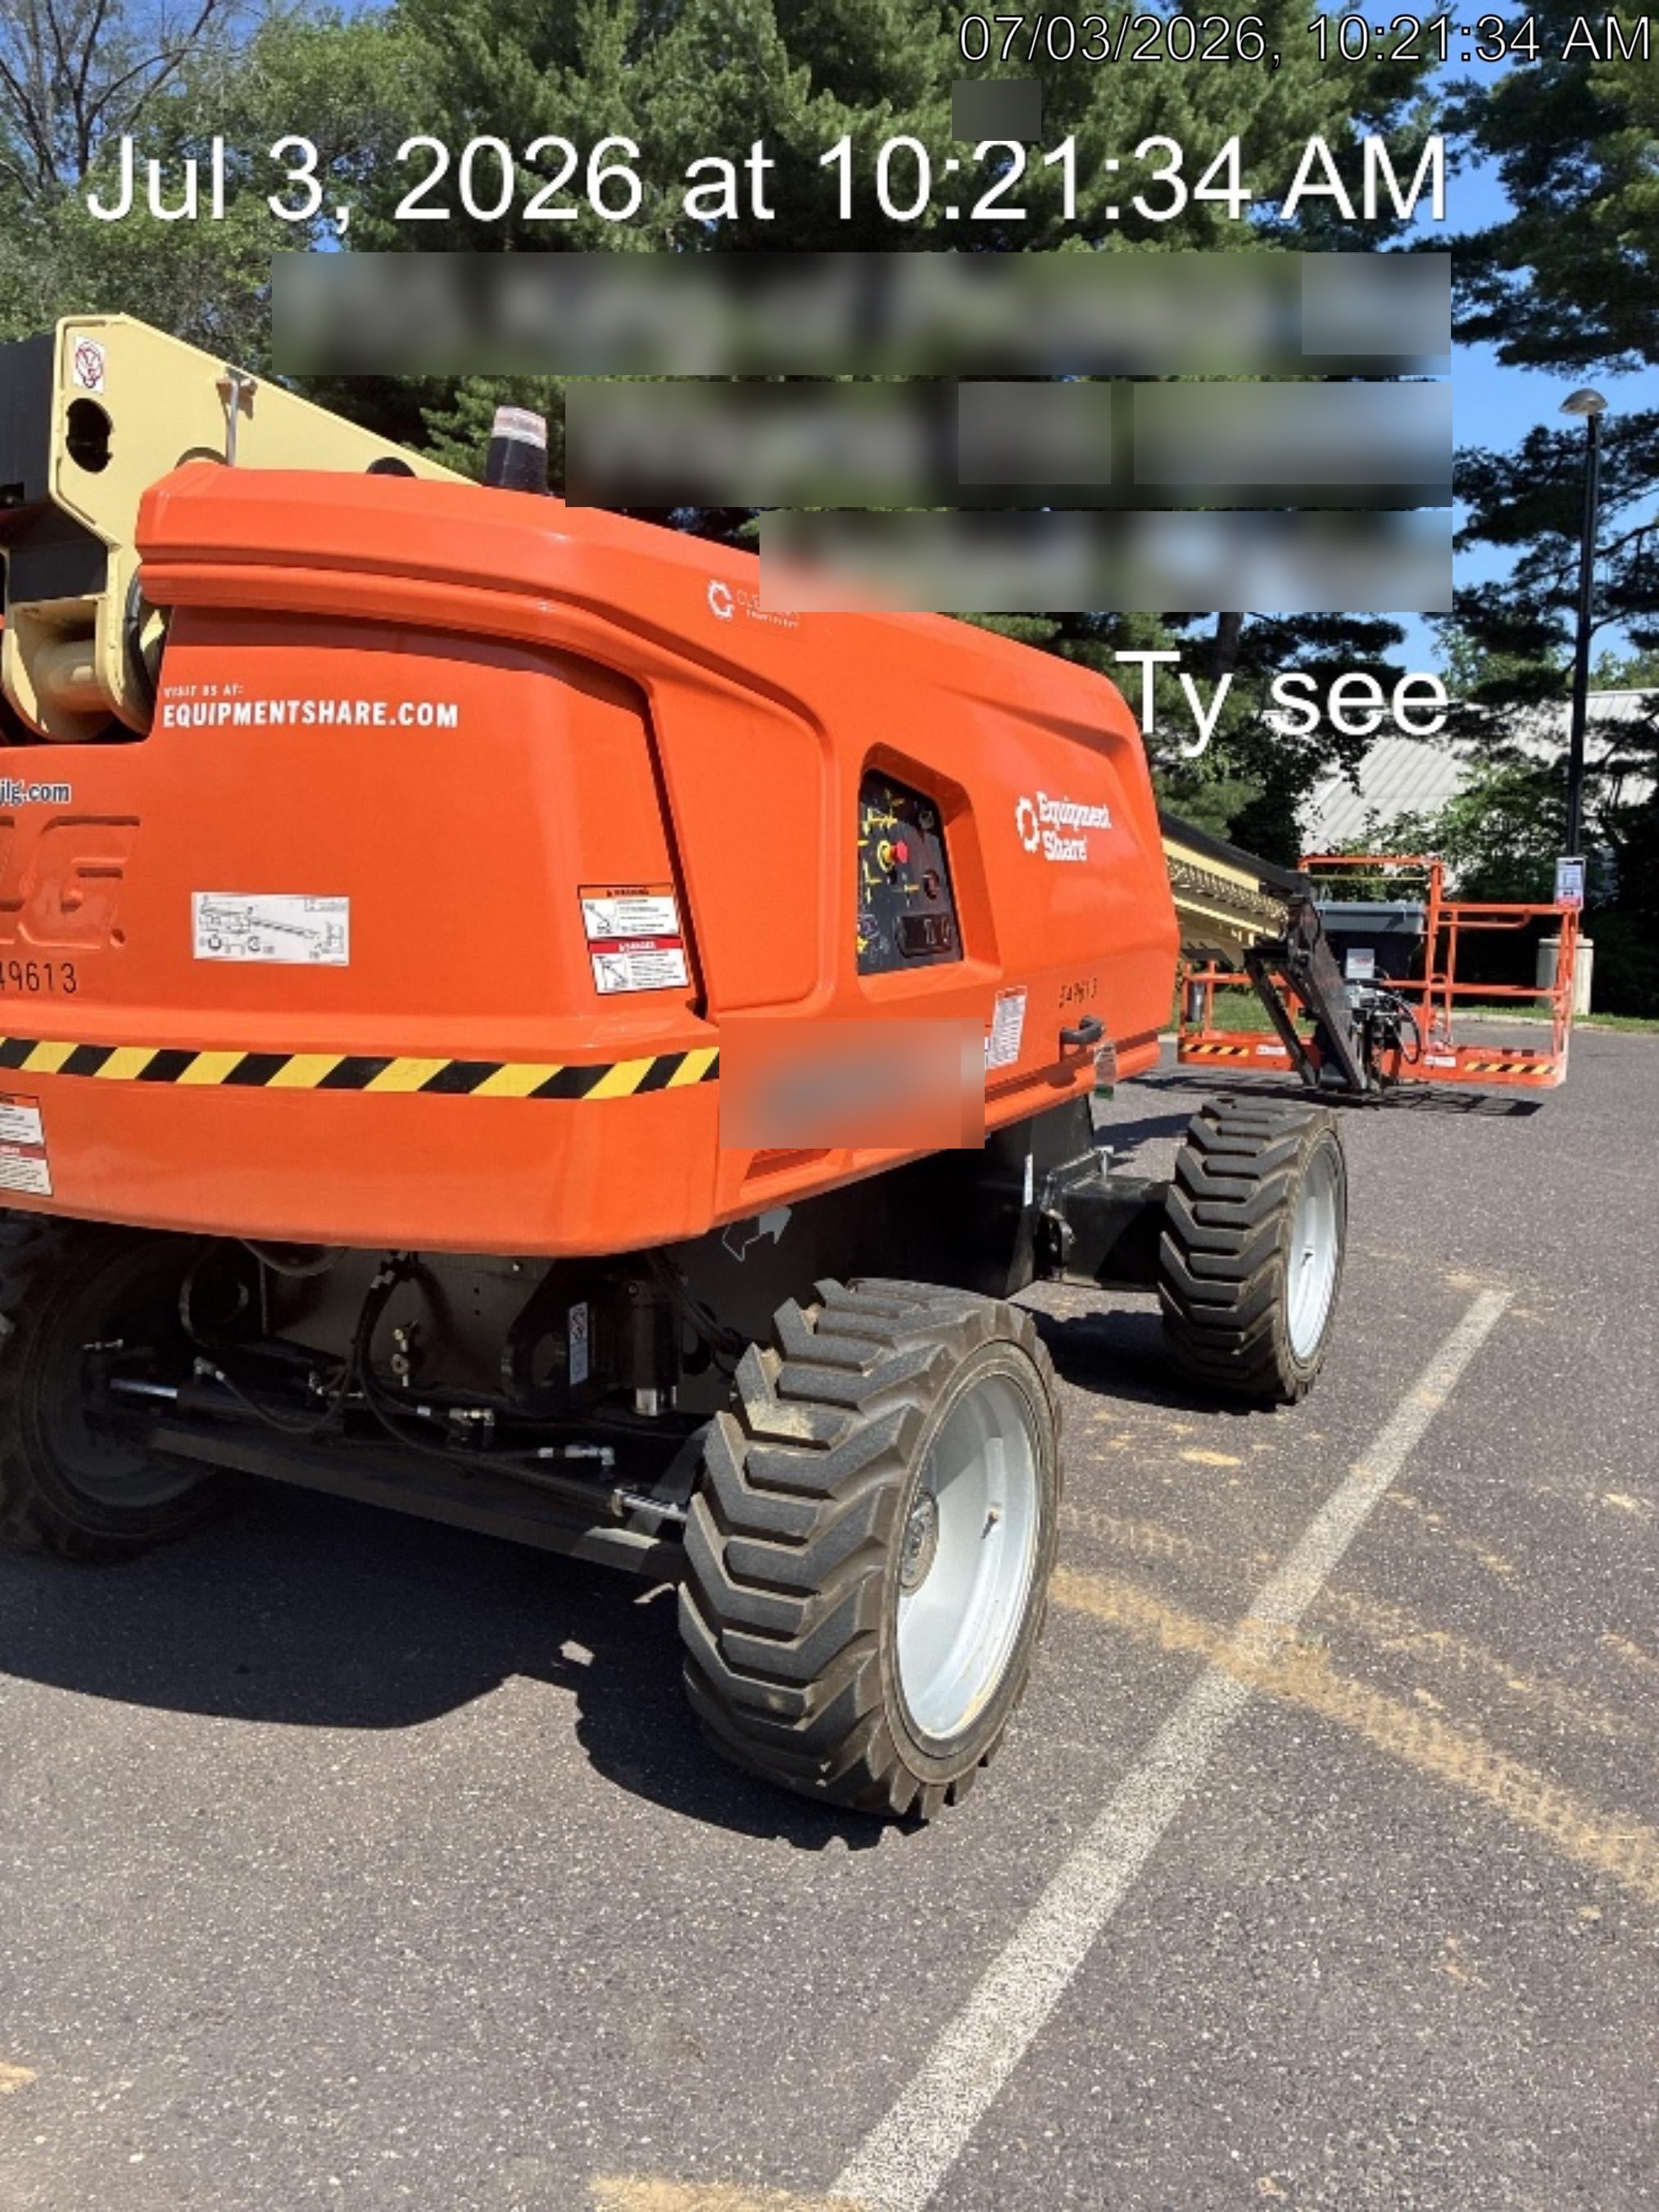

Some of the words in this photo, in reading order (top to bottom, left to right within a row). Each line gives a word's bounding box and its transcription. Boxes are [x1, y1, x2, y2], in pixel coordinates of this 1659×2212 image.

[163, 699, 460, 728] EQUIPMENTSHARE.COM
[1036, 791, 1112, 832] Equipment
[1042, 830, 1088, 861] Share
